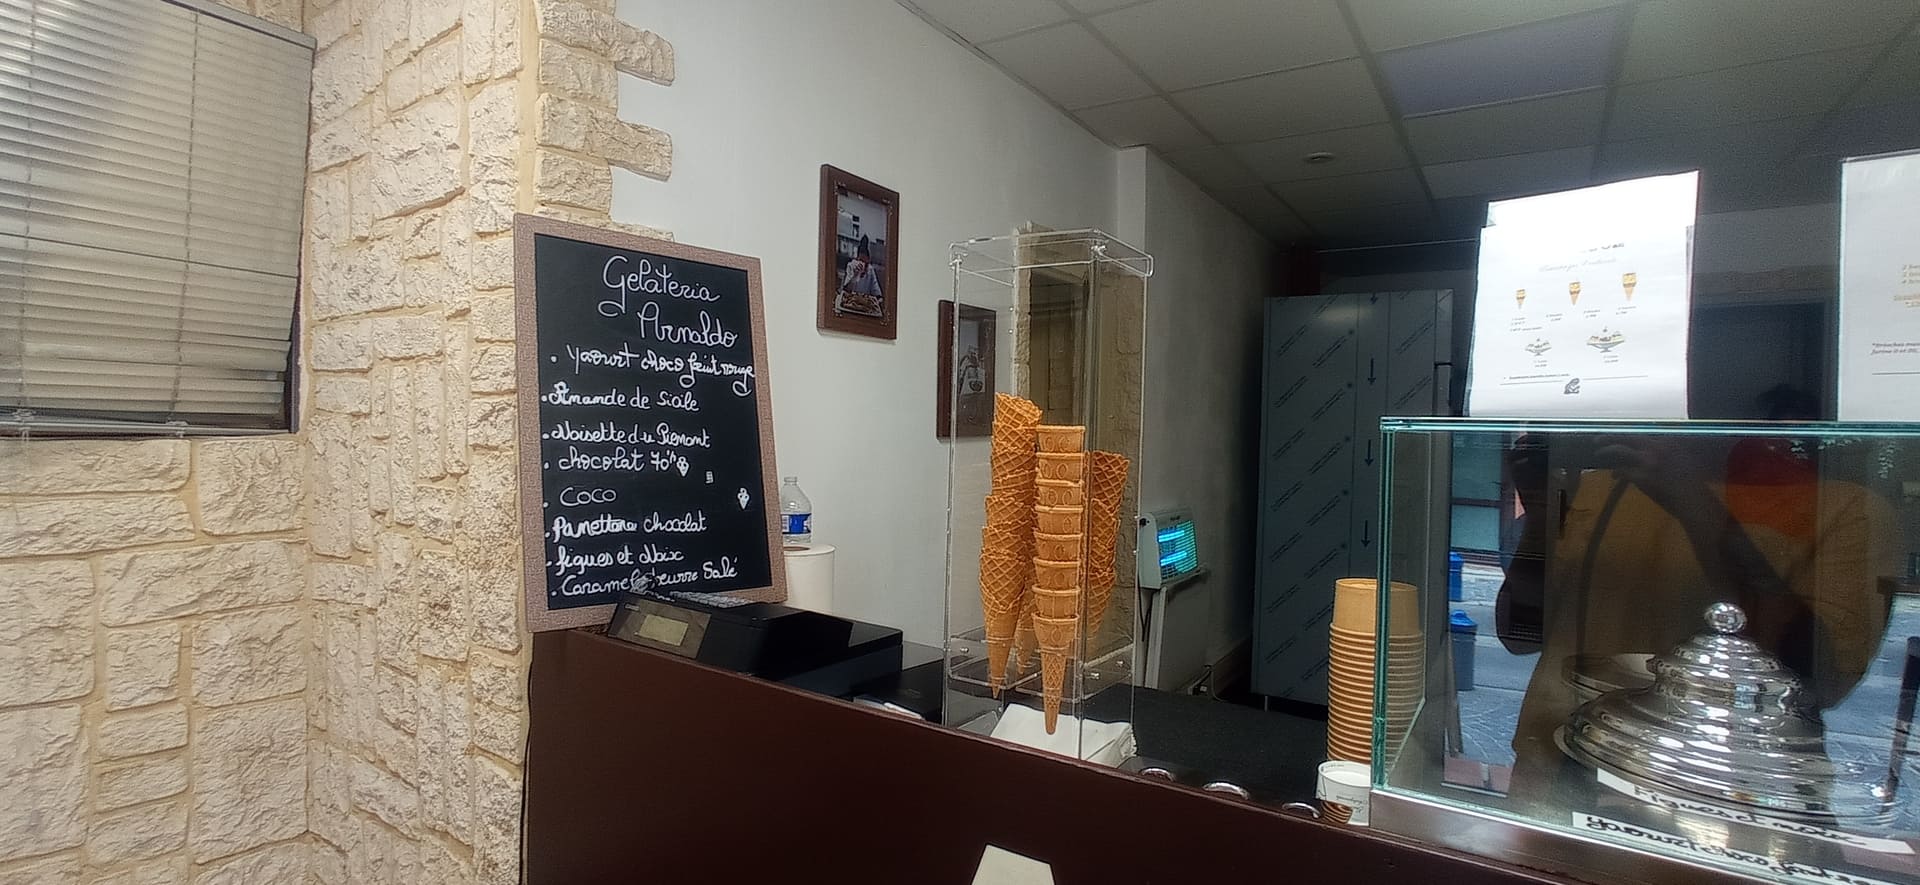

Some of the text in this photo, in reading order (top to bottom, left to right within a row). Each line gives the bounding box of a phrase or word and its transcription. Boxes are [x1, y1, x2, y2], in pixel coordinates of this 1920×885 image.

[598, 256, 720, 317] Gelateria
[637, 302, 738, 348] Arnaldo
[641, 350, 684, 372] choco
[679, 352, 722, 389] fruit
[720, 362, 756, 396] rouge
[548, 381, 626, 406] Amande
[630, 387, 651, 410] de
[551, 420, 626, 444] Noisette
[628, 424, 655, 444] du
[616, 546, 634, 565] et
[561, 568, 642, 597] Caramel
[702, 556, 738, 580] Salé
